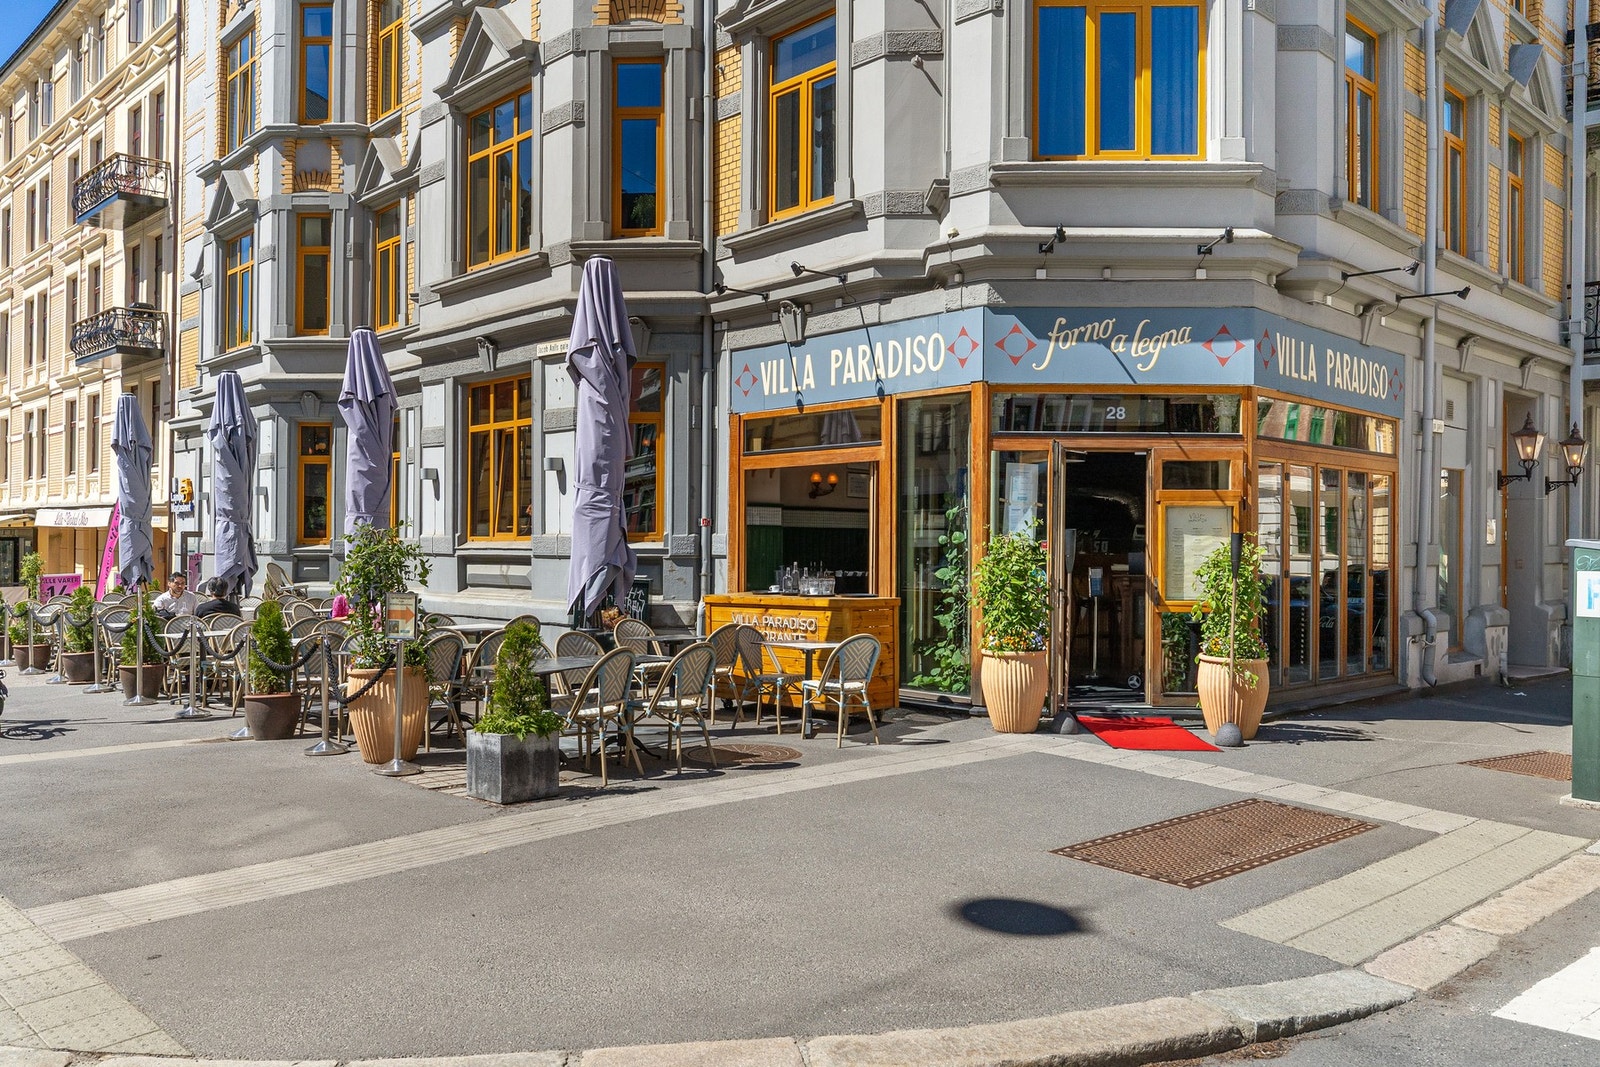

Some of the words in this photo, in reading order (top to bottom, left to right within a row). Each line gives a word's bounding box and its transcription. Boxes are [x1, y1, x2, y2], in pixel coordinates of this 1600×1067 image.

[760, 354, 815, 396] VILLA
[830, 332, 946, 386] PARADISO
[1032, 317, 1116, 371] forno
[1111, 334, 1128, 353] a
[1130, 319, 1192, 372] legna
[1276, 332, 1317, 383] VILLA
[1326, 348, 1388, 400] PARADISO
[1106, 406, 1126, 420] 28
[731, 613, 759, 626] VILLA
[762, 615, 816, 631] PARADISO
